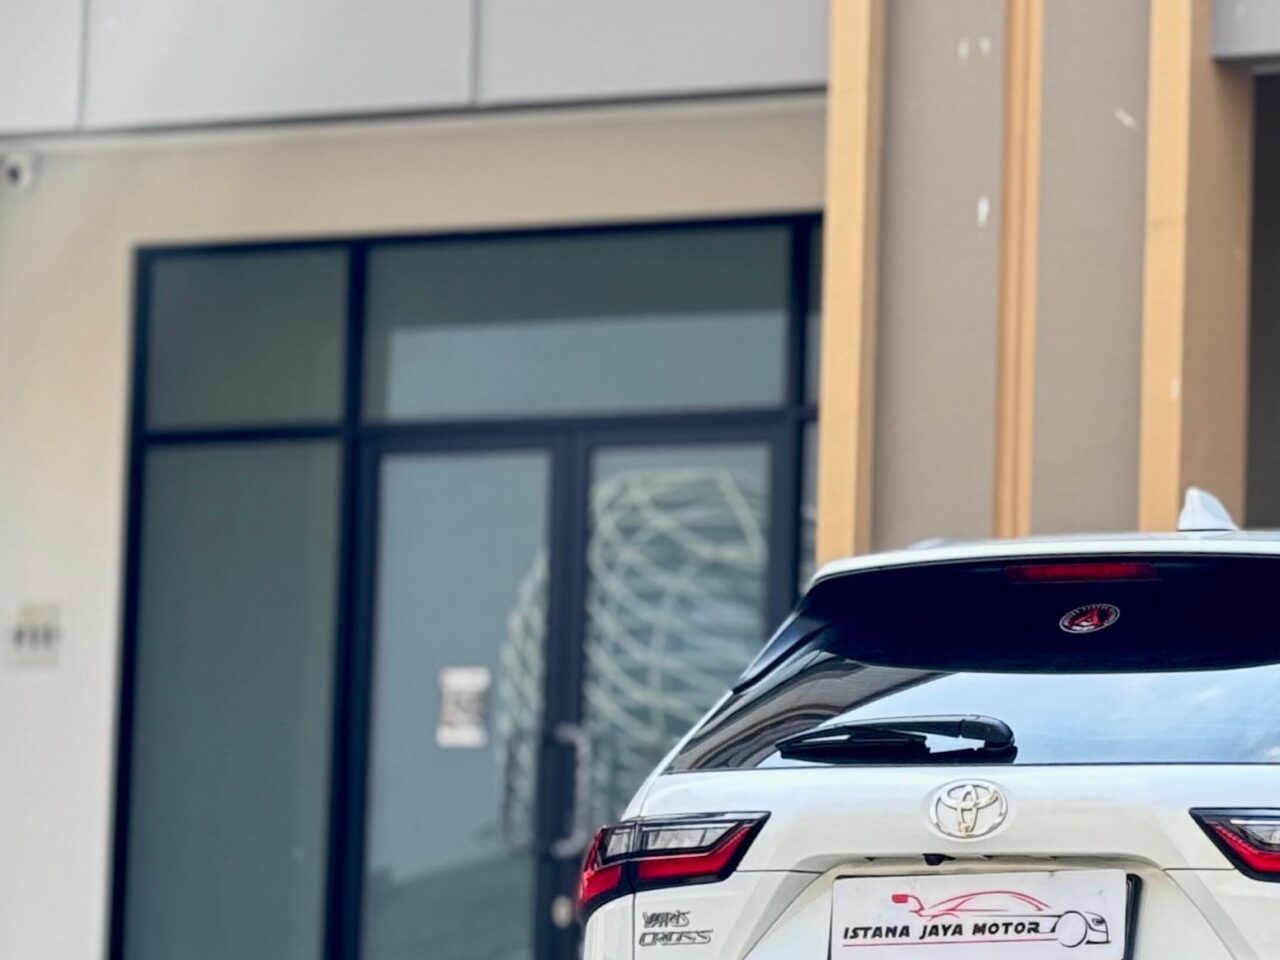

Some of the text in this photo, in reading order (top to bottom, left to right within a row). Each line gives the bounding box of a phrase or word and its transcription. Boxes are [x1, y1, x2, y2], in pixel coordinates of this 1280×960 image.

[639, 929, 714, 947] CROSS
[843, 920, 1041, 940] ISTANA JAYA MOTOR
